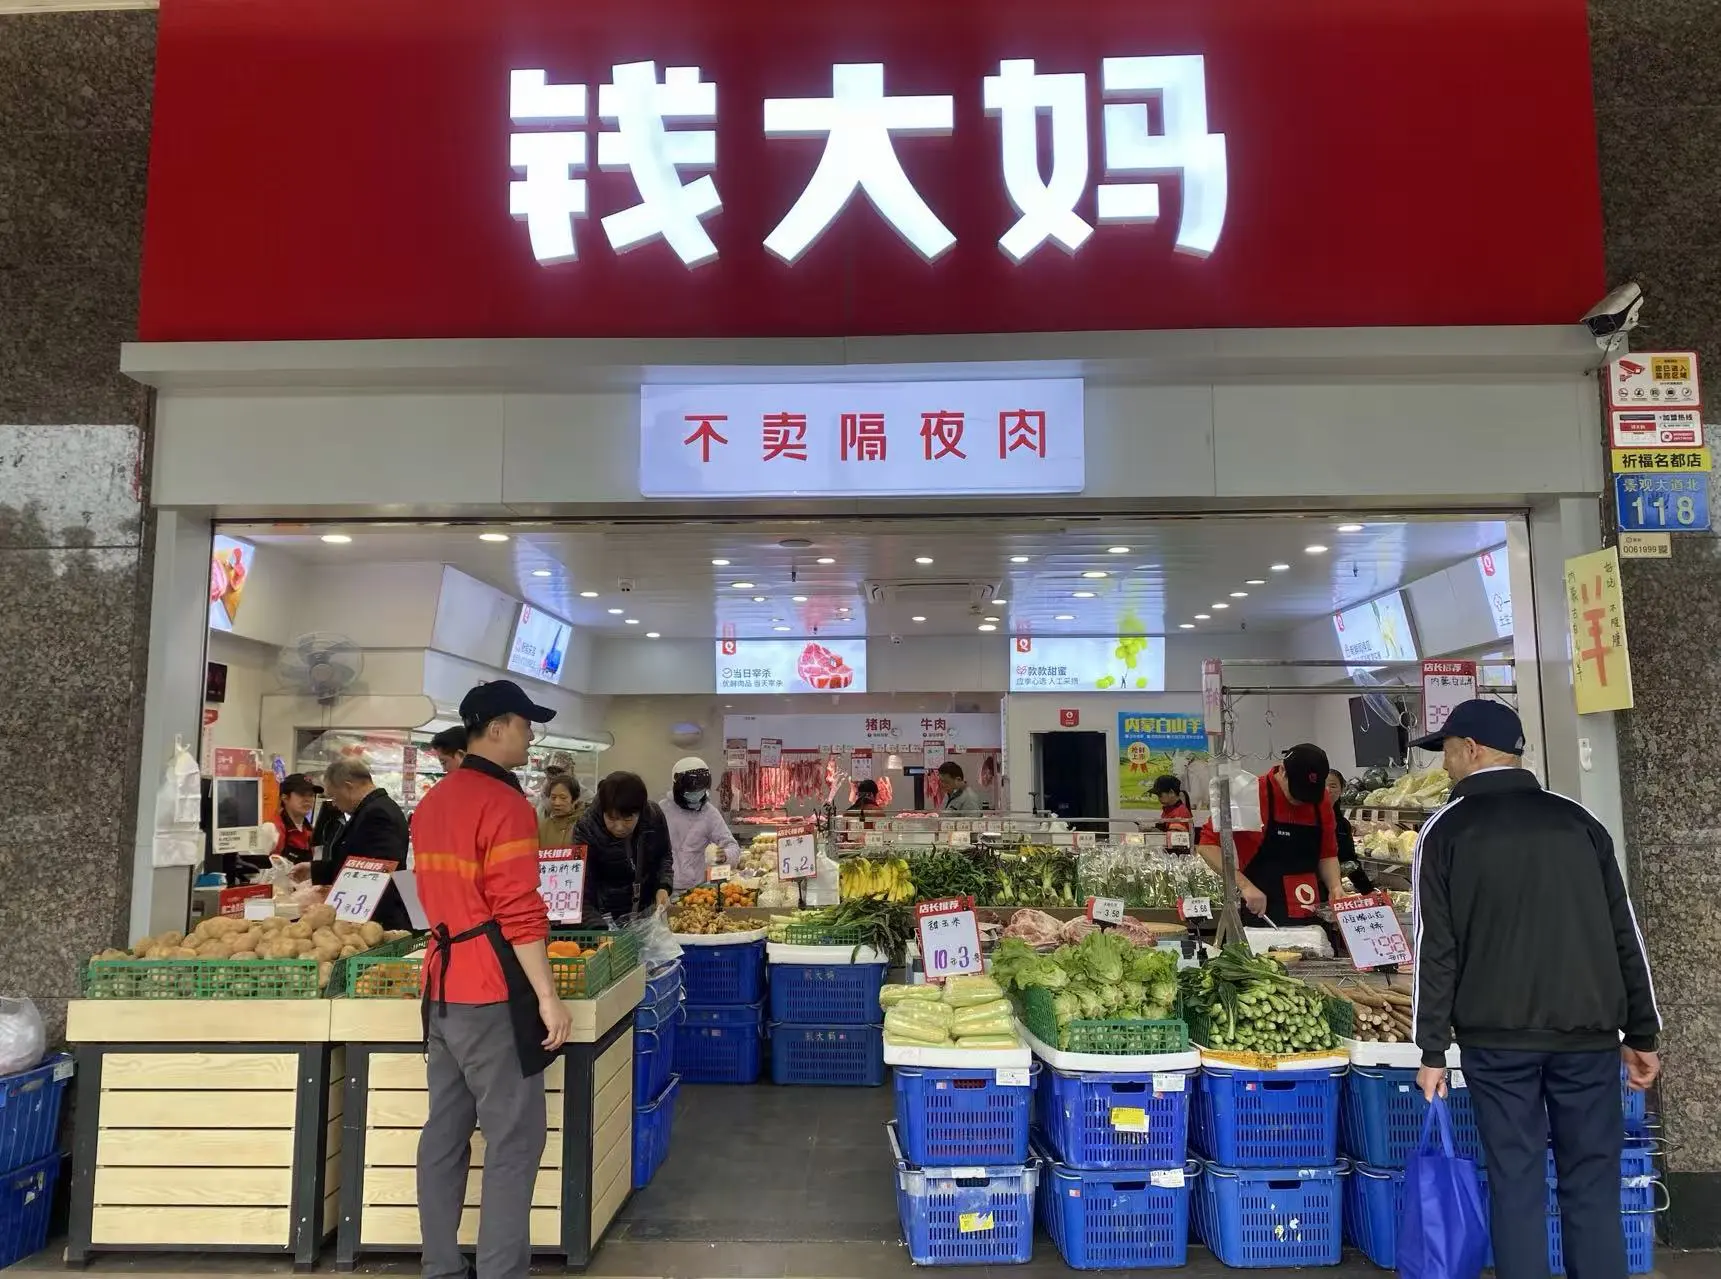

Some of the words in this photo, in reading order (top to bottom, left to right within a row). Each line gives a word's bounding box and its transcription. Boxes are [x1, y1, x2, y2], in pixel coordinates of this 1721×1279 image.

[508, 54, 1228, 268] 钱大妈
[684, 409, 1046, 463] 不卖隔夜肉
[1622, 453, 1702, 469] 祈福名都店
[1623, 478, 1700, 492] 景观大道北
[1632, 496, 1695, 526] 118
[732, 668, 771, 679] 当日宰杀
[1028, 666, 1067, 676] 款款甜蜜
[1424, 663, 1462, 672] 店长推荐
[865, 718, 891, 731] 猪肉
[920, 717, 946, 731] 牛肉
[1125, 717, 1202, 733] 内蒙白山羊
[919, 900, 961, 914] 店长推荐
[1333, 897, 1375, 912] 店长推荐
[928, 916, 960, 931] 甜玉米
